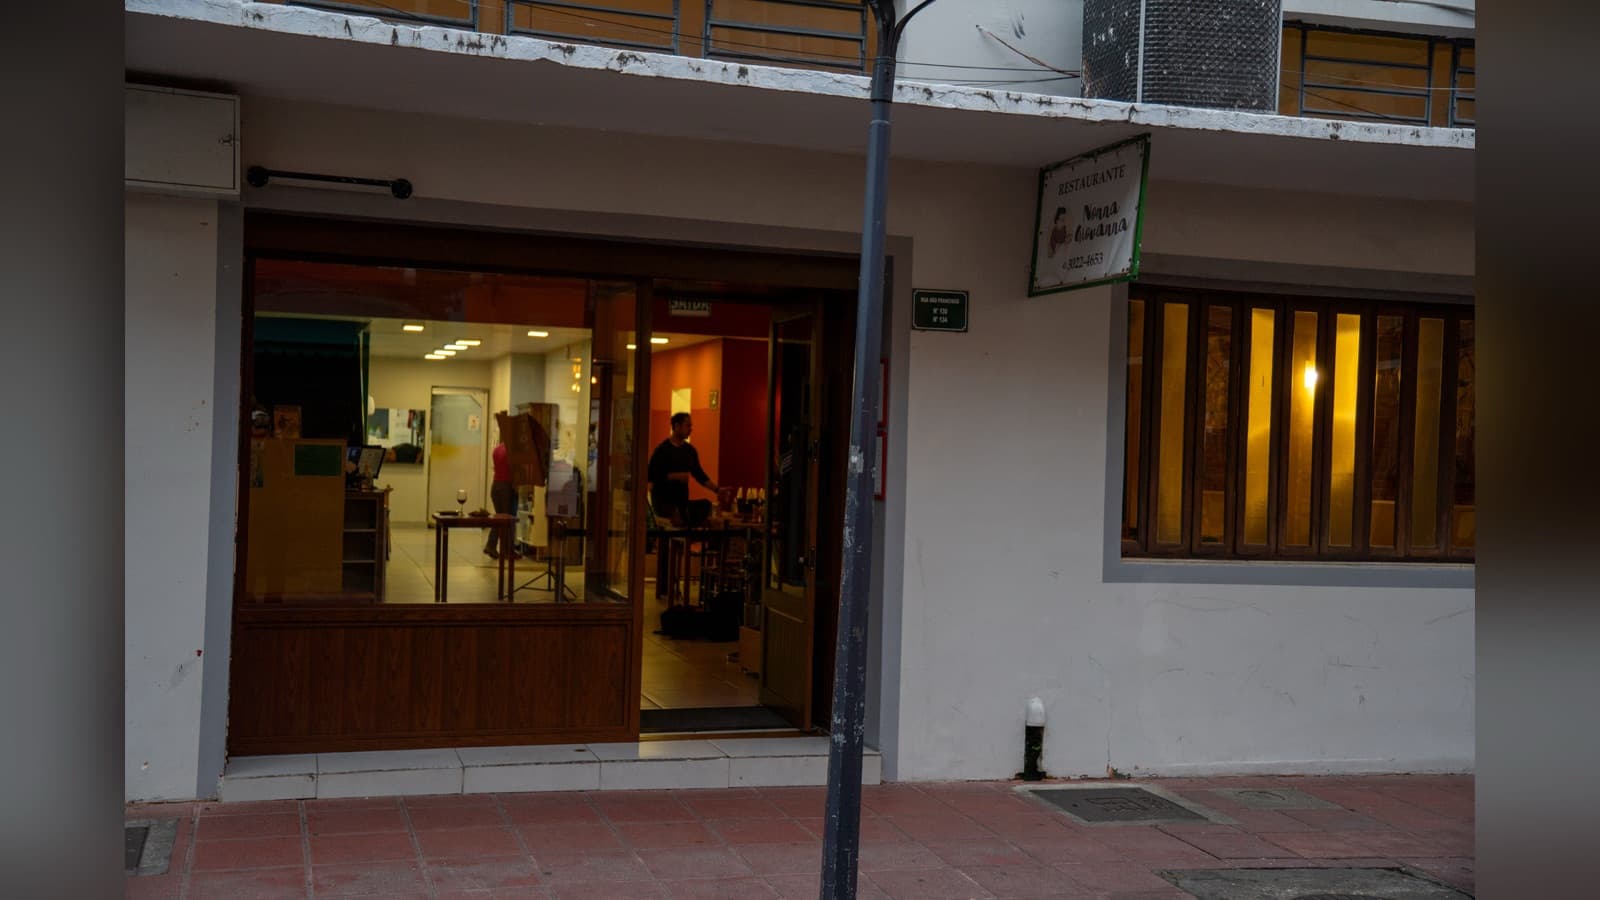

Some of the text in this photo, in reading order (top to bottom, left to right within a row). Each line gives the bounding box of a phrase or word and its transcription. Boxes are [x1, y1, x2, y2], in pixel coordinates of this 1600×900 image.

[1058, 166, 1125, 195] RESTAURANTE
[1082, 201, 1120, 222] Nonna
[1075, 217, 1128, 242] Giovanna
